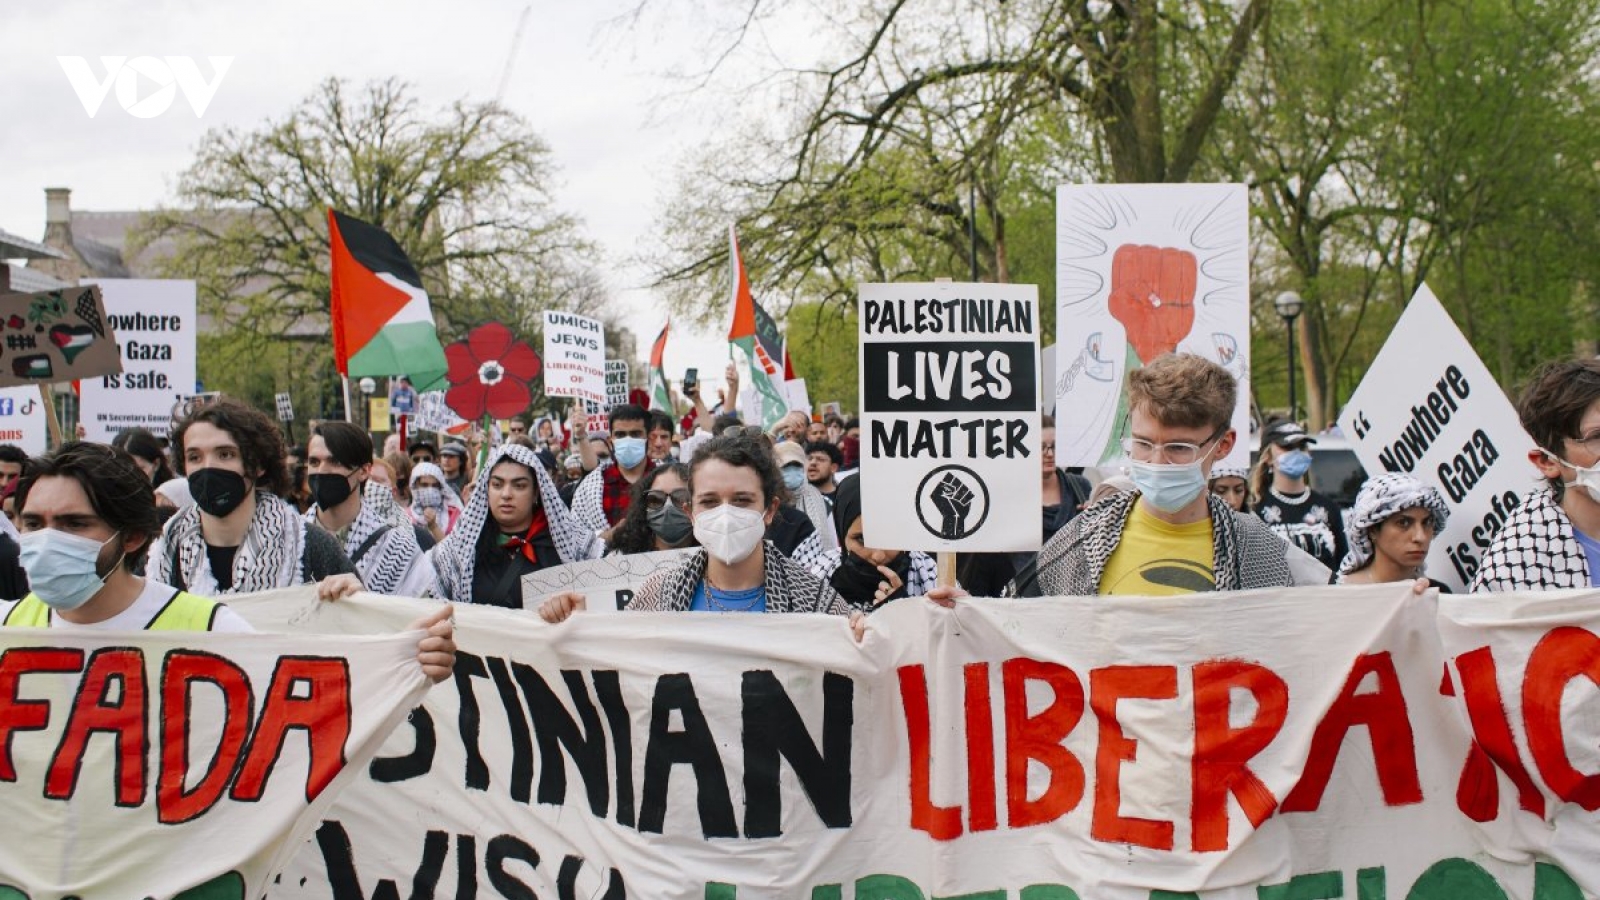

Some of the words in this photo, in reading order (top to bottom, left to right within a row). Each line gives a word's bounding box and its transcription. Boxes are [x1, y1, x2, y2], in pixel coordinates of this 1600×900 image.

[548, 313, 599, 333] UMICH
[864, 299, 1033, 334] PALESTINIAN
[127, 340, 172, 360] Gaza
[551, 333, 598, 350] JEWS
[565, 351, 587, 361] FOR
[125, 370, 172, 389] safe.
[546, 362, 604, 377] LIBERATION
[570, 375, 584, 384] OF
[887, 350, 1012, 401] LIVES
[546, 386, 605, 402] PALESTINE
[108, 414, 146, 423] Secretary
[1378, 364, 1470, 474] Nowhere
[871, 419, 1031, 459] MATTER
[1437, 428, 1501, 504] Gaza
[1446, 543, 1479, 587] is
